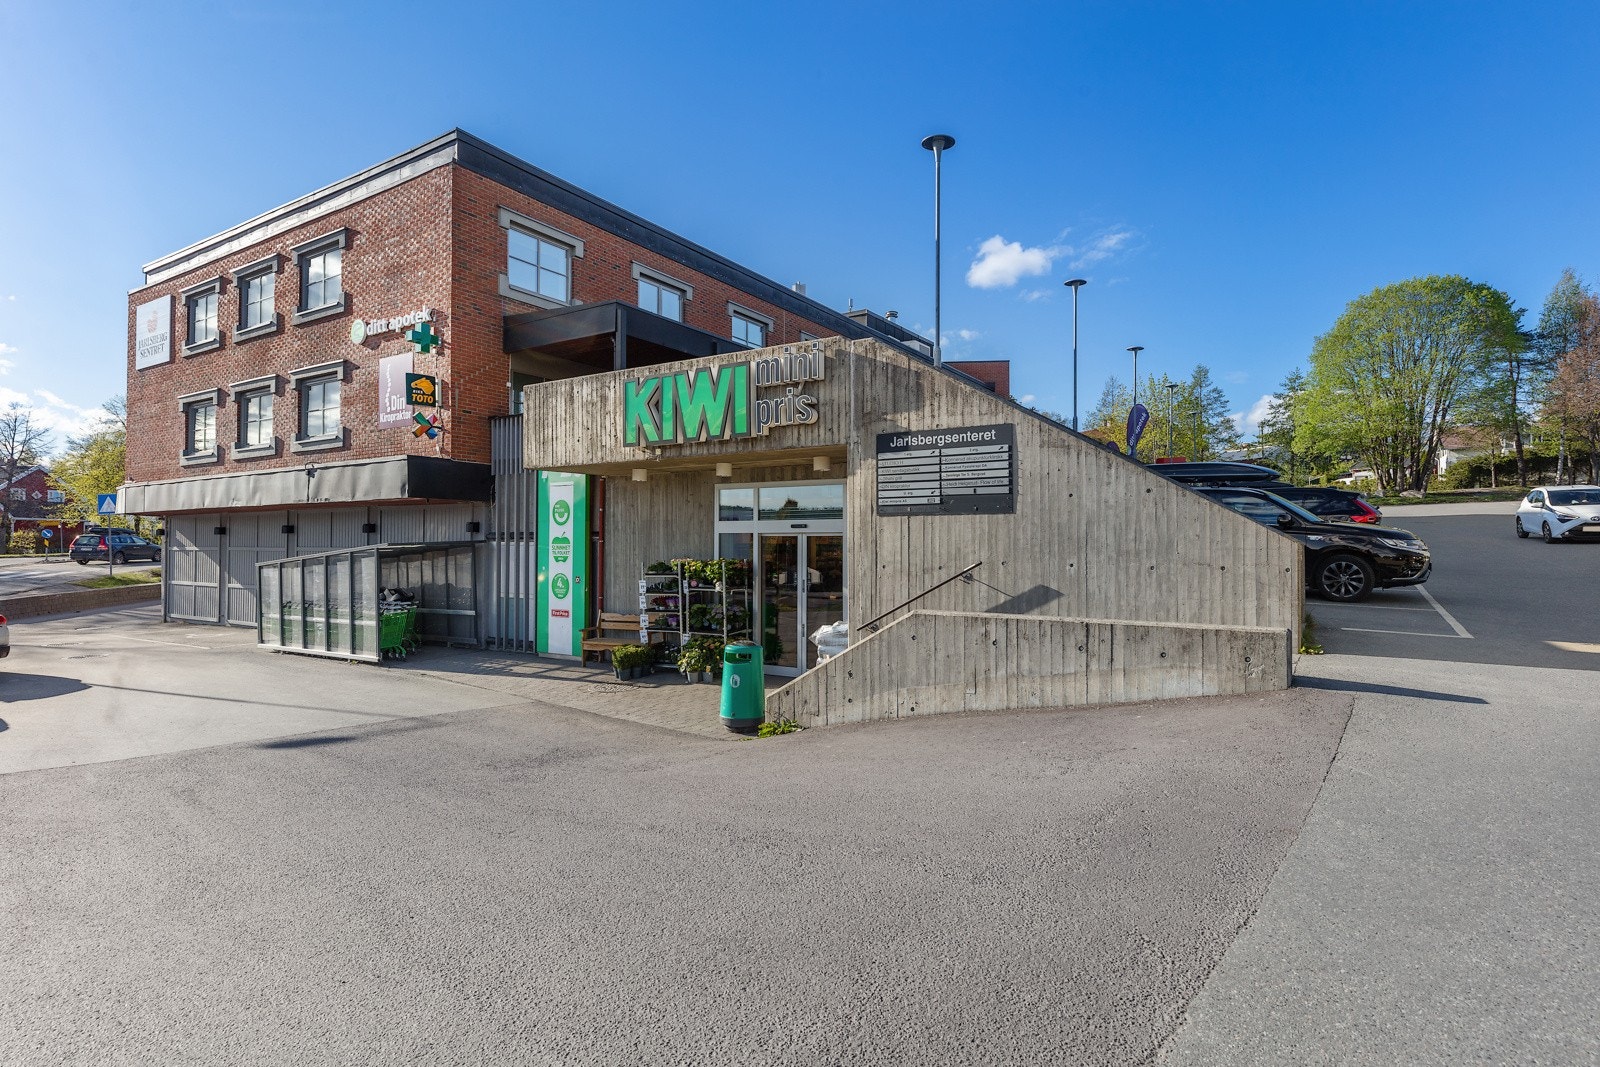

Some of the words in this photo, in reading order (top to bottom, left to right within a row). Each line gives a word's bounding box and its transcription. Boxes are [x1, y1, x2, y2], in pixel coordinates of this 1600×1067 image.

[366, 319, 388, 336] ditt
[388, 306, 432, 332] apotek
[138, 332, 168, 351] JARLSBERG
[139, 343, 165, 359] SENTRET
[755, 341, 823, 386] mini
[391, 395, 406, 411] Din
[412, 394, 433, 403] TOTO
[623, 361, 752, 447] KIWI
[380, 411, 412, 423] Kiropraktor
[755, 387, 817, 436] pris
[890, 429, 996, 447] Jarlsbergsenteret
